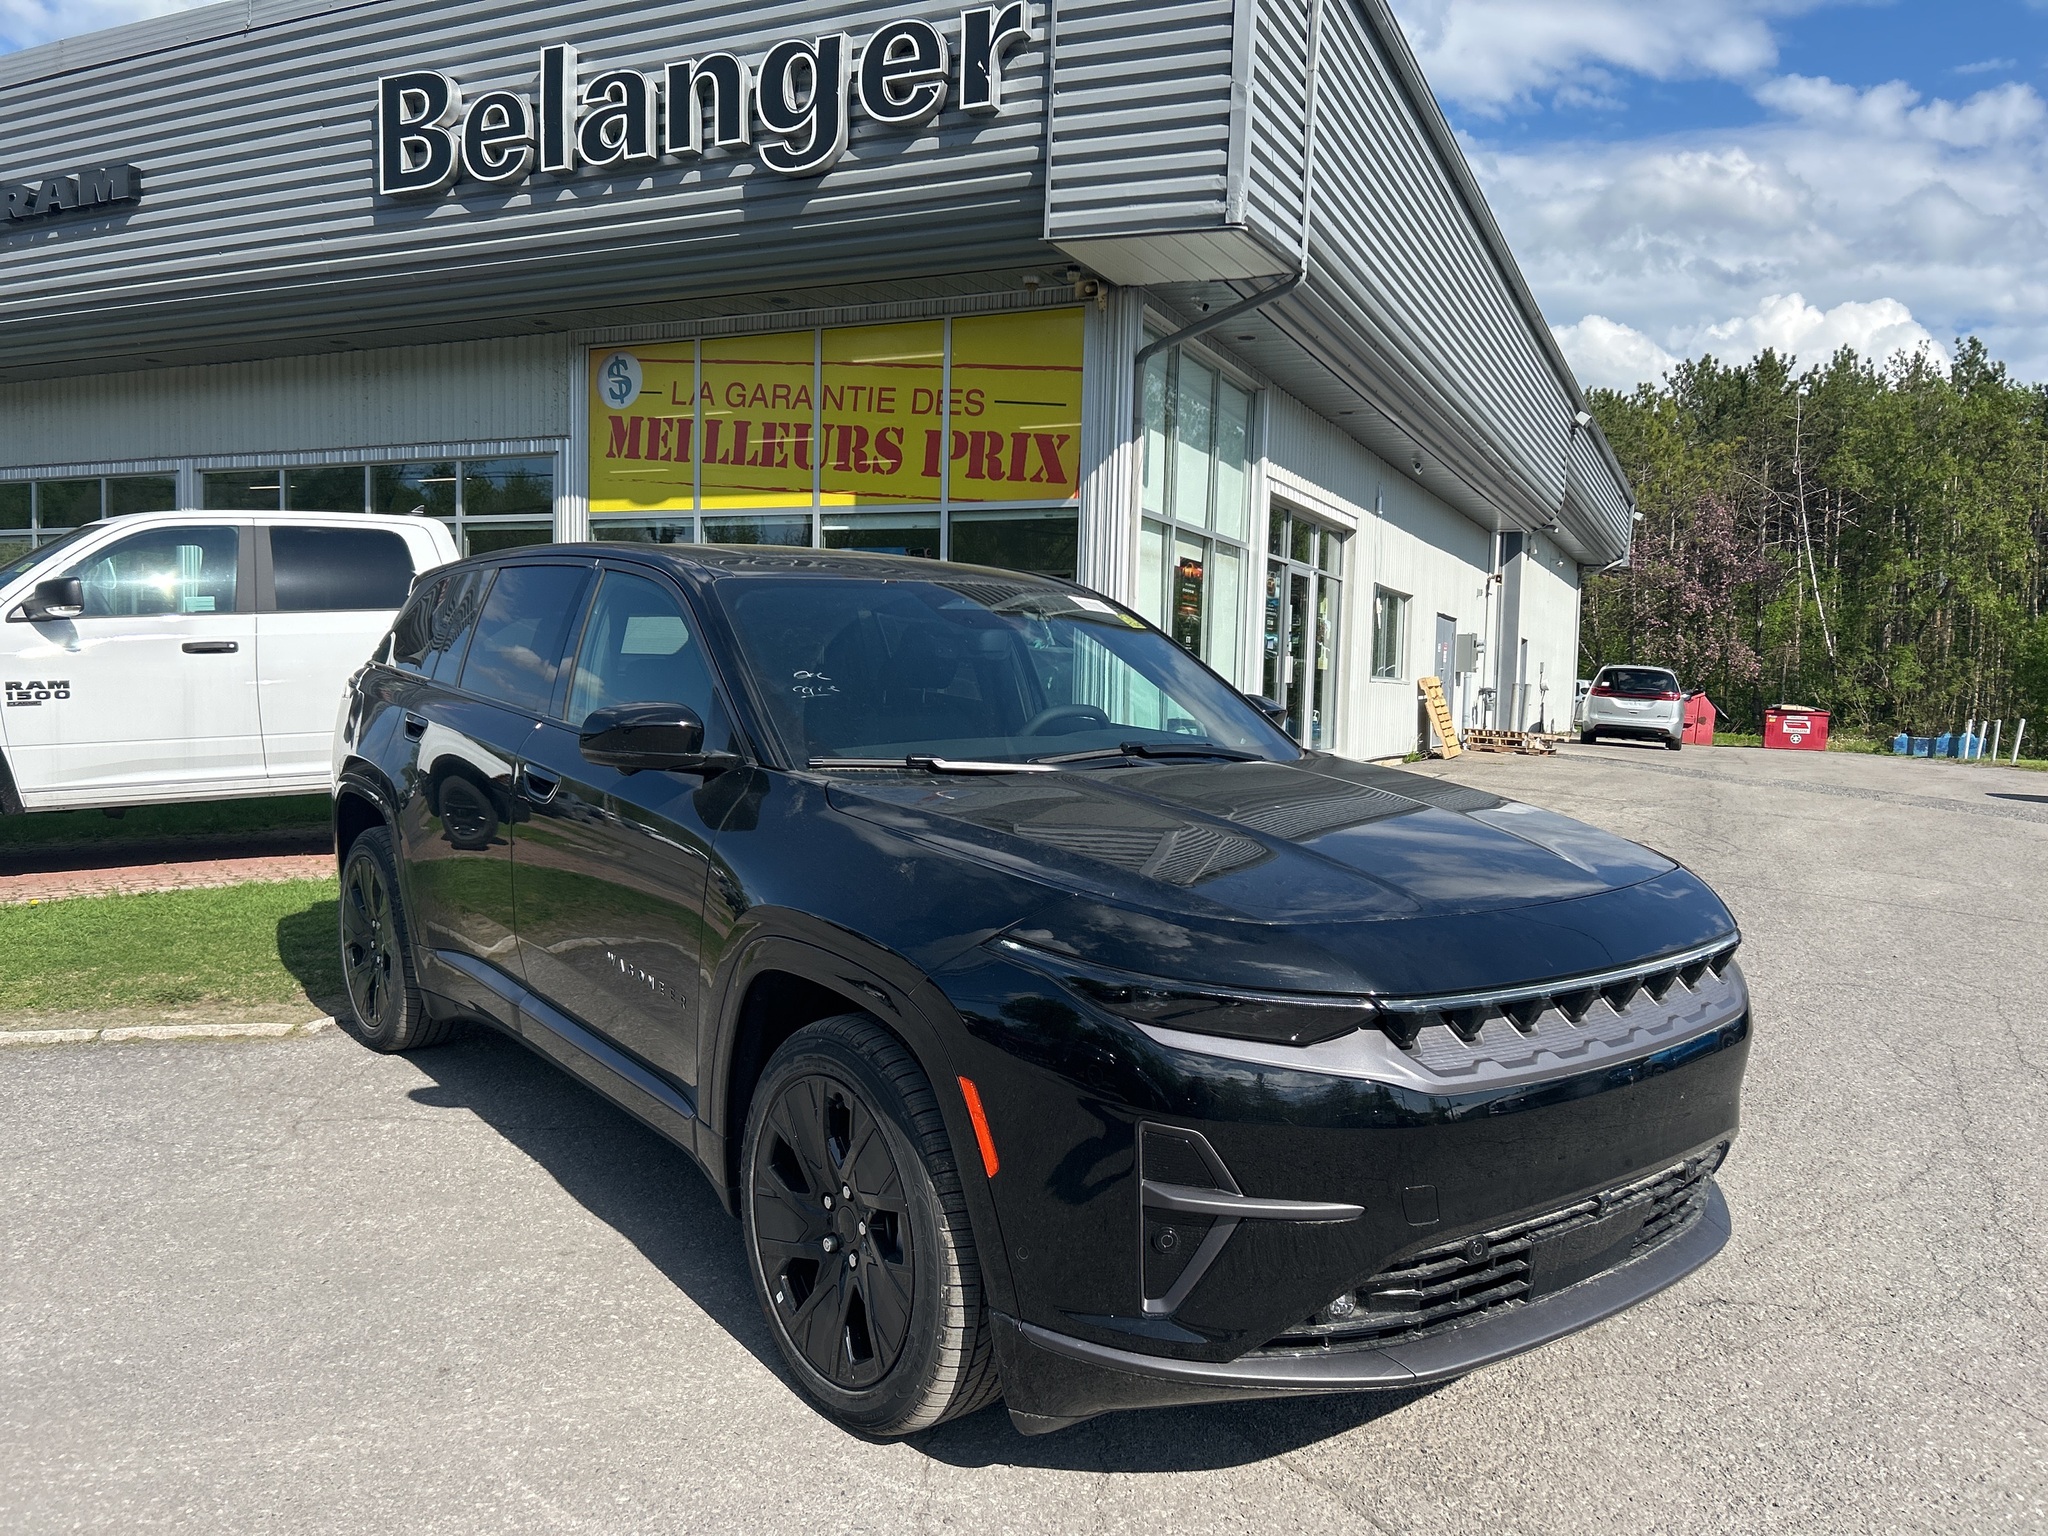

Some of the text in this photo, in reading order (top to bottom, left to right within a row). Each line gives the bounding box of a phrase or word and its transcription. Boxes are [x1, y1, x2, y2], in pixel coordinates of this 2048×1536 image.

[378, 0, 1026, 195] Belanger
[0, 163, 141, 222] RAM
[671, 381, 985, 416] LA GARANTIE DES
[605, 415, 1071, 484] MEILLEURS PRIX
[5, 680, 70, 690] RAM
[6, 690, 70, 700] 1500
